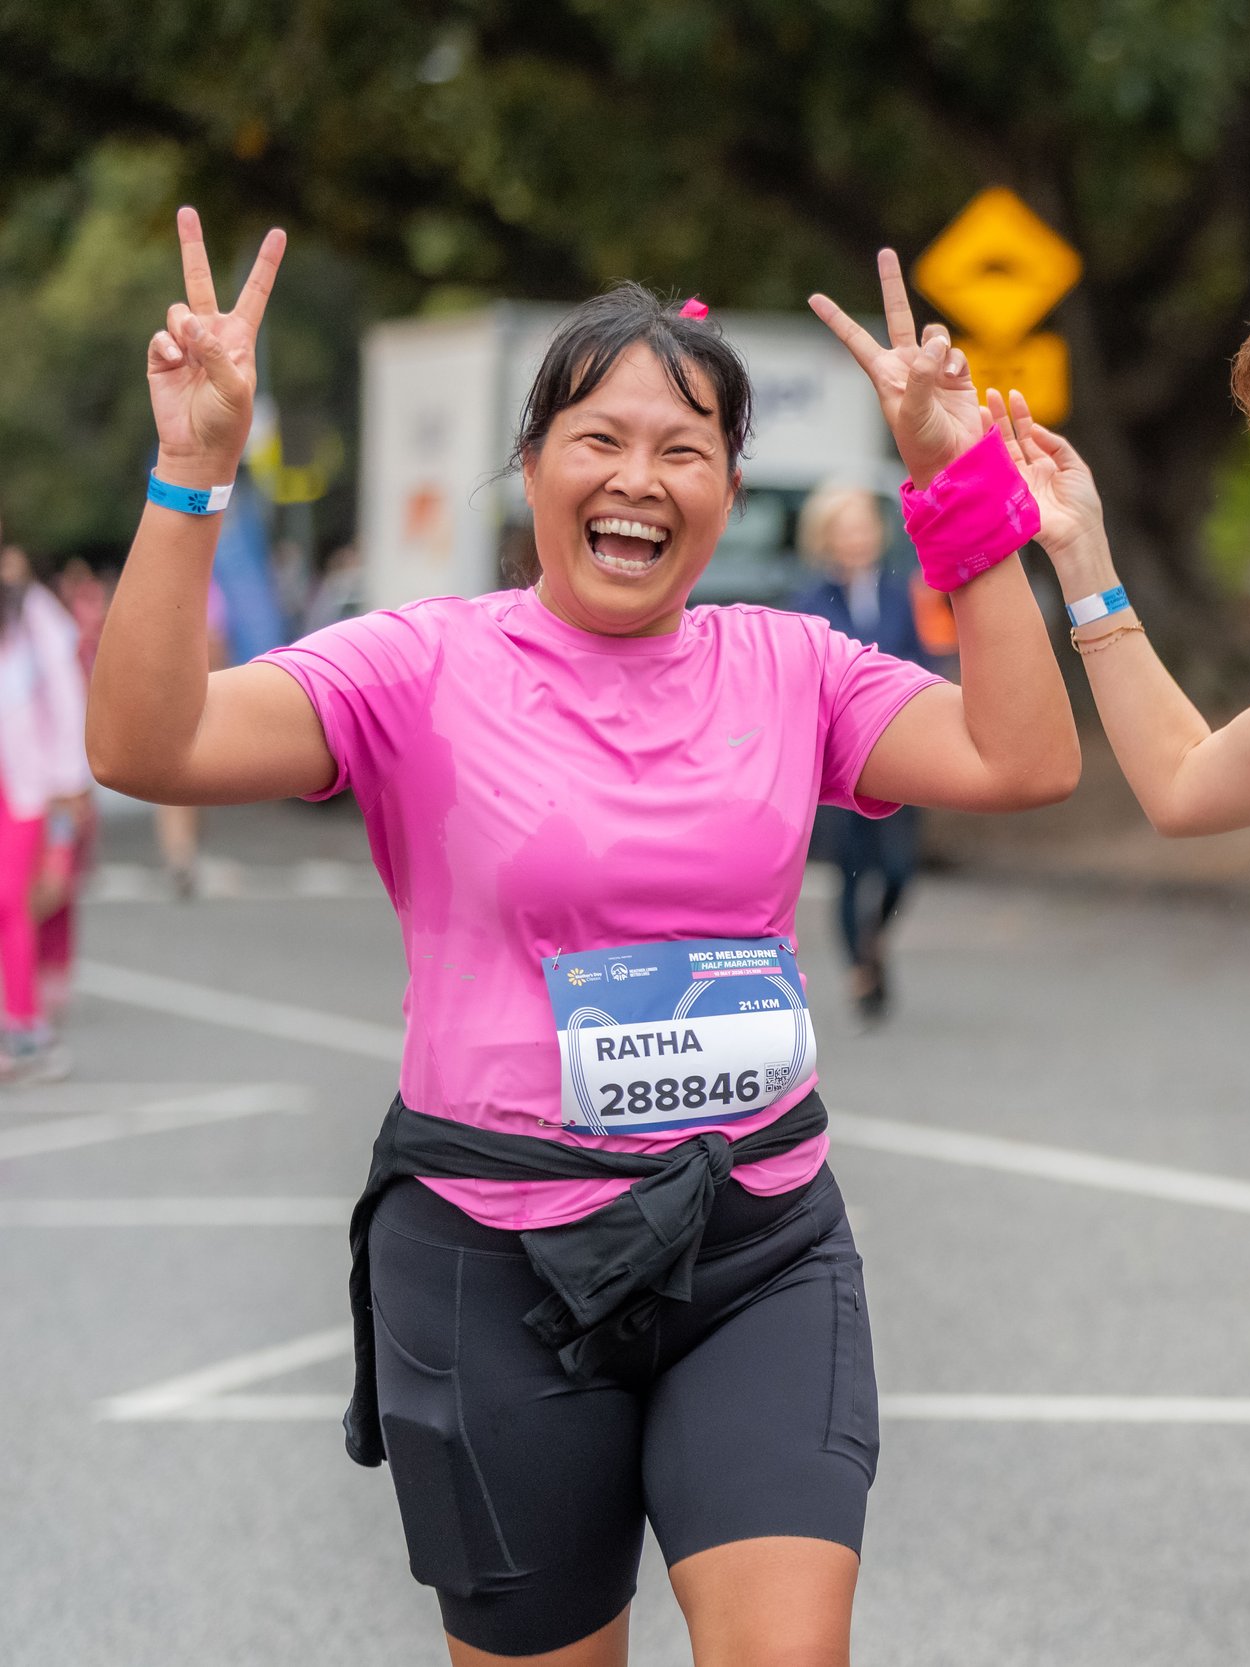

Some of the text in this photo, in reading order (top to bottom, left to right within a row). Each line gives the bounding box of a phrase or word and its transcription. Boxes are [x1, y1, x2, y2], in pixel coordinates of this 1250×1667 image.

[689, 949, 778, 962] MDC MELBOURNE
[701, 959, 770, 970] HALF MARATHON
[739, 999, 780, 1011] 21.1 KM
[596, 1029, 704, 1062] RATHA
[599, 1069, 760, 1117] 288846
